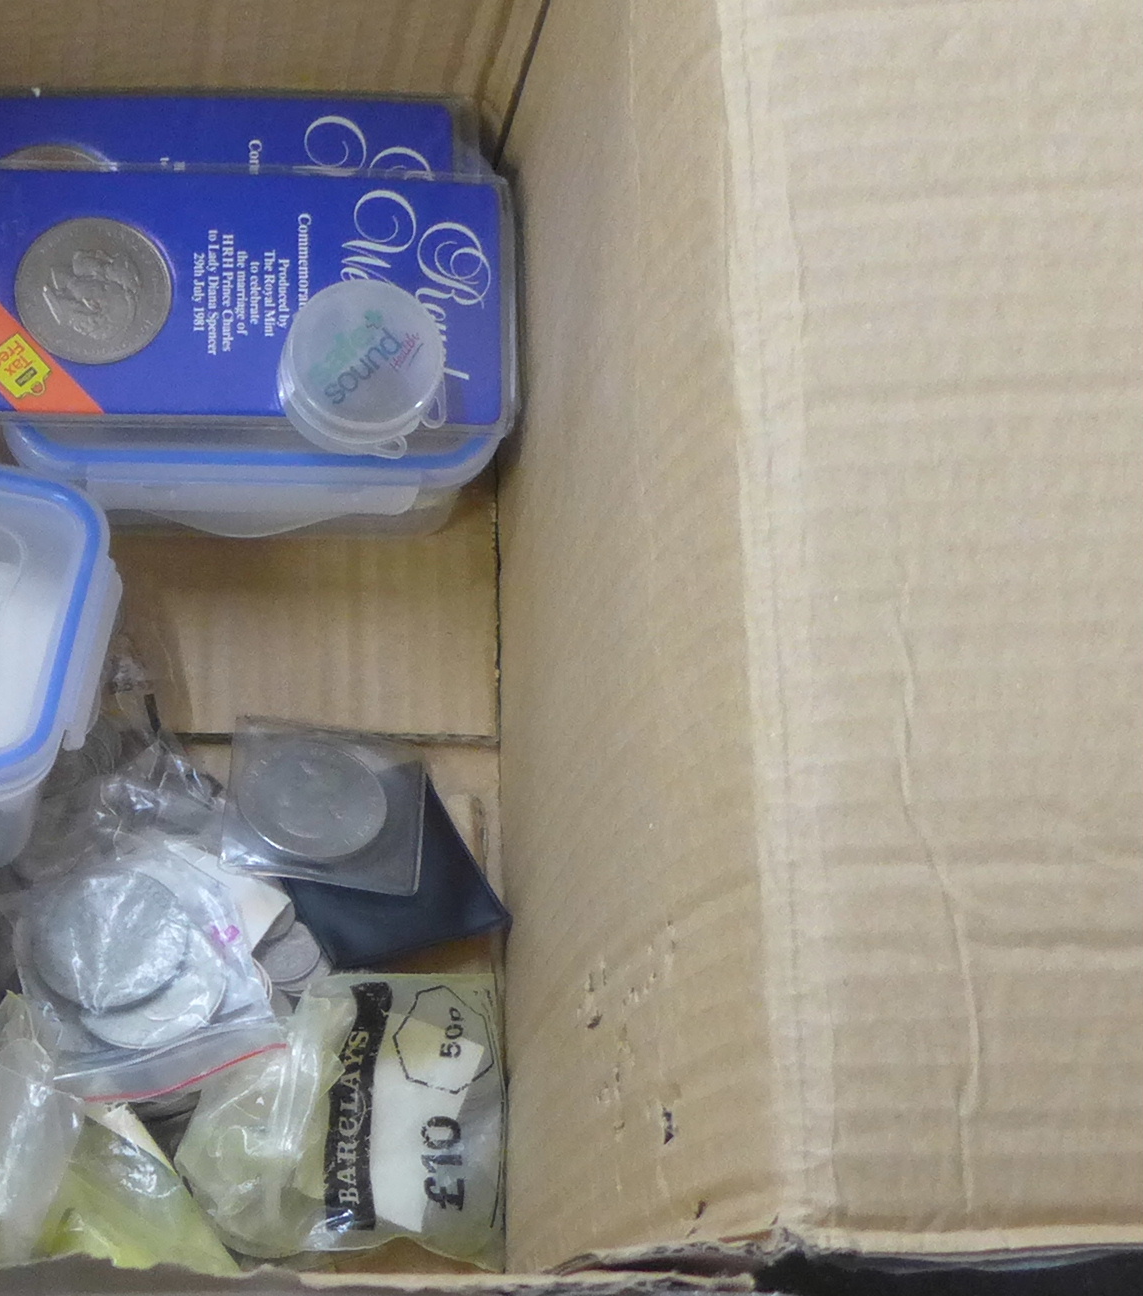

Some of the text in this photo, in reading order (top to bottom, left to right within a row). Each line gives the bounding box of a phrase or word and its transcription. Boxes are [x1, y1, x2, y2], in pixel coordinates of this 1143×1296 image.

[191, 252, 205, 332] 29th July 1981
[206, 229, 220, 356] to Lady Diana Spencer
[222, 271, 234, 307] Prince
[235, 251, 248, 336] the marriage of
[250, 261, 262, 325] to celebrate
[262, 249, 276, 337] The Royal Mint
[277, 259, 290, 329] Produced by
[298, 213, 312, 310] Commemorat
[3, 355, 33, 376] Tax
[222, 309, 234, 352] Charles
[324, 327, 403, 405] sound
[439, 1006, 465, 1059] 50p
[337, 1029, 369, 1205] BARCLAYS
[420, 1115, 465, 1212] £10
